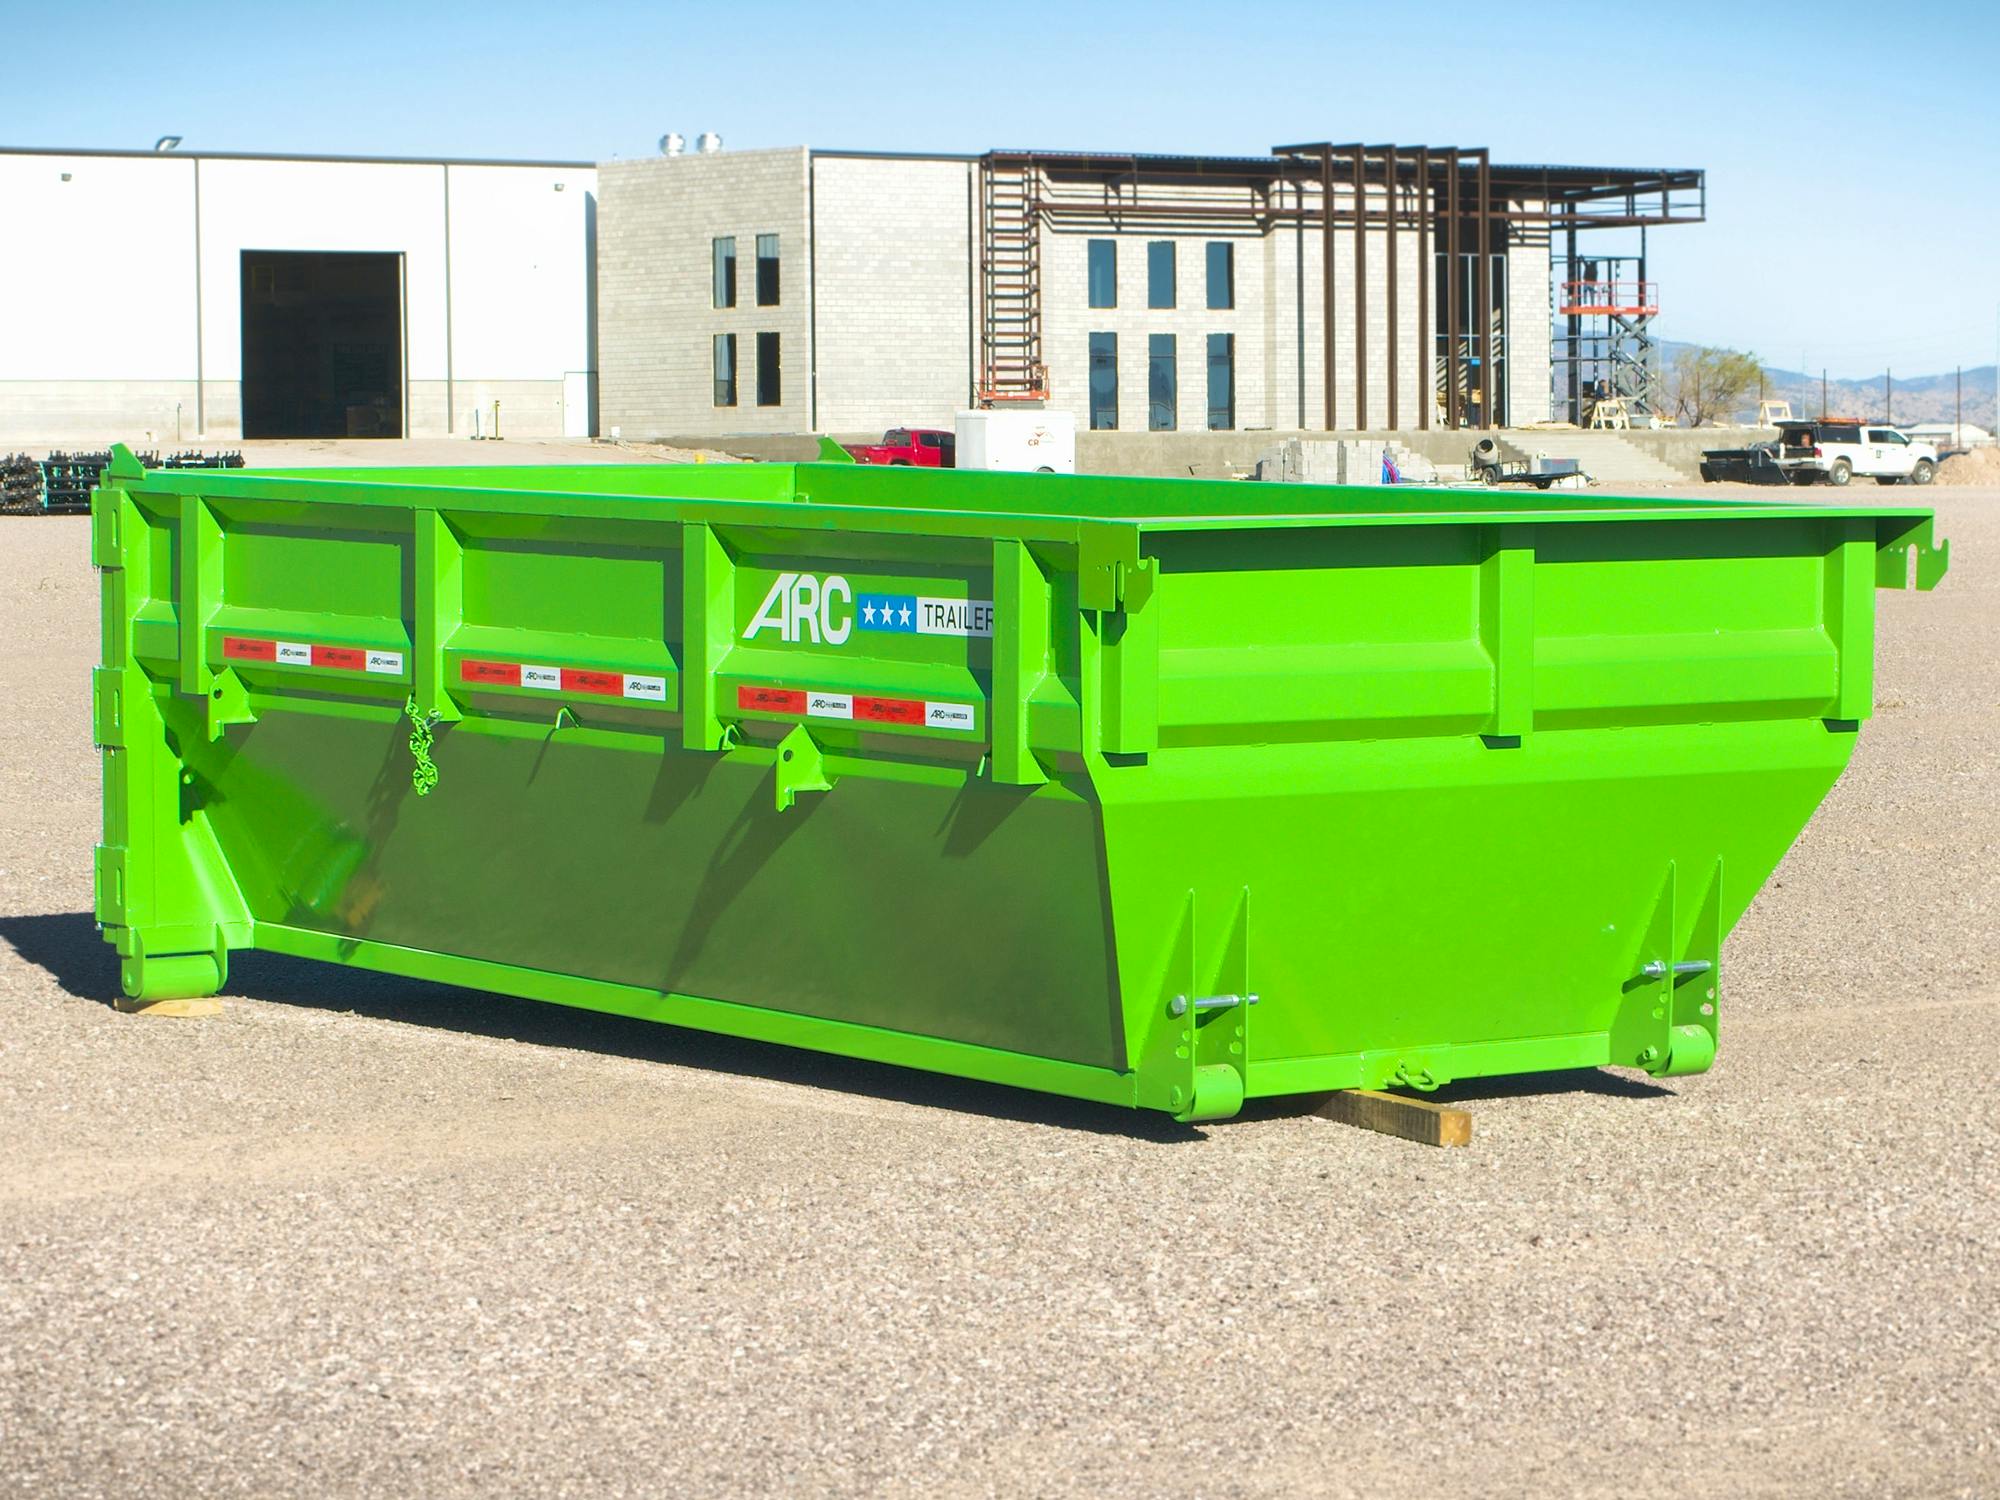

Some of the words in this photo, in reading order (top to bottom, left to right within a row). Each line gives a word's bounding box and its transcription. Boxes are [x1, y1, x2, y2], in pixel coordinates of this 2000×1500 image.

[742, 573, 852, 645] ARC
[812, 699, 826, 709] ARC
[931, 709, 945, 719] ARC
